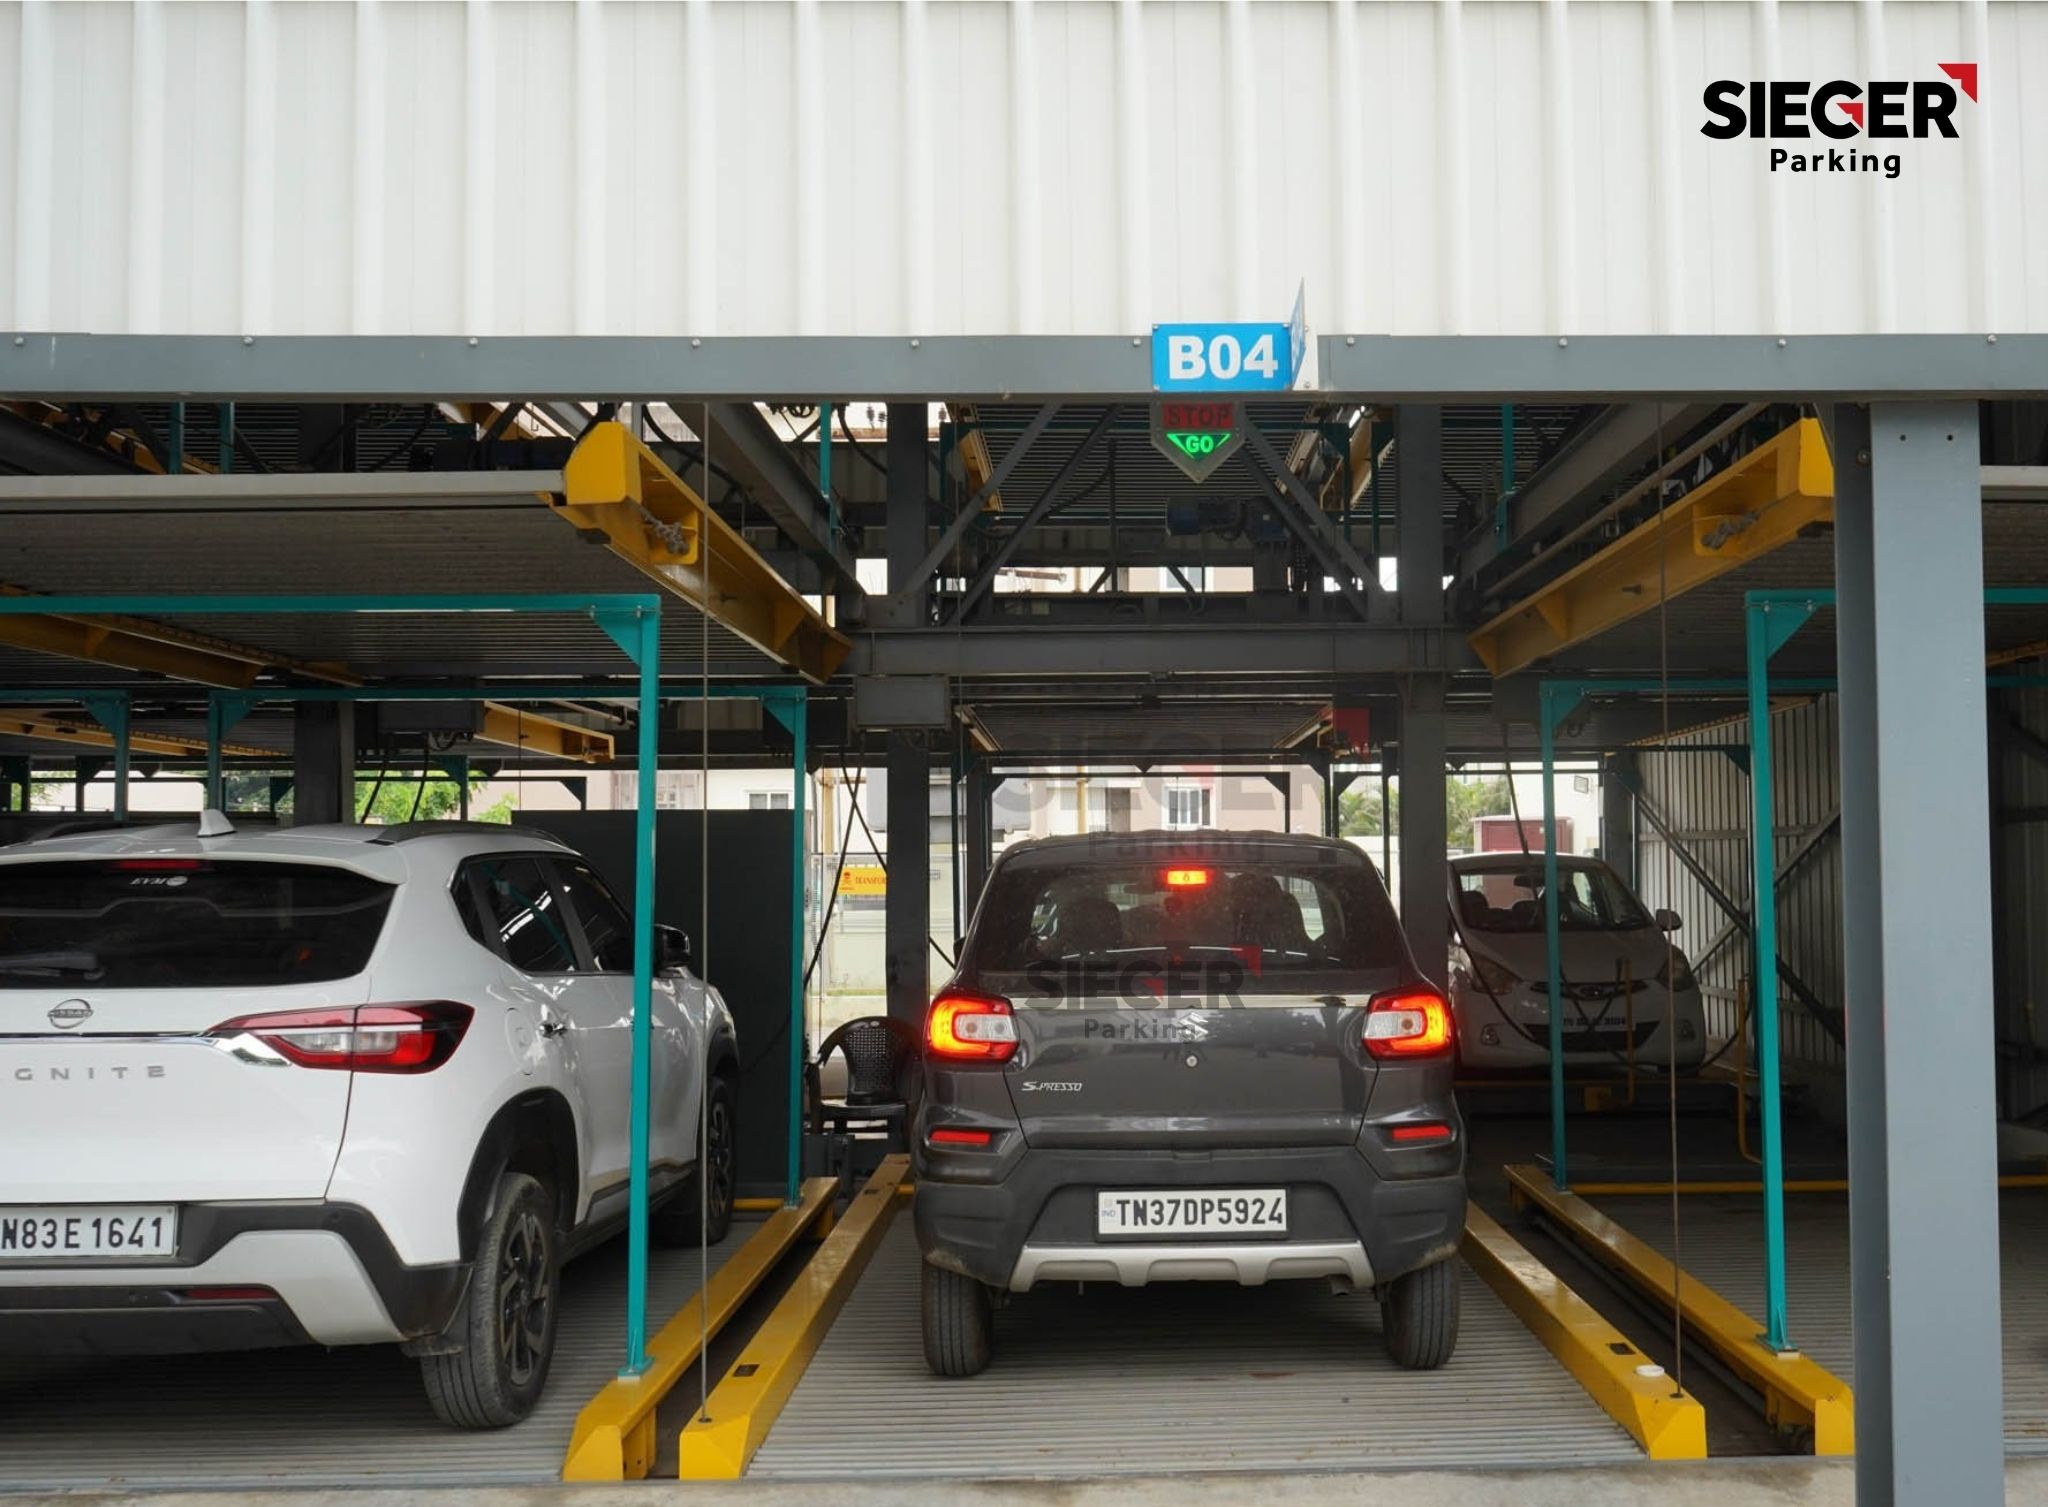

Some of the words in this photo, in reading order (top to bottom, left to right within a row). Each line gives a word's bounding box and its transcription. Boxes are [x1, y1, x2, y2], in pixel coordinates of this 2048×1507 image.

[1168, 334, 1279, 380] B04
[1166, 405, 1233, 427] STOP
[1185, 436, 1214, 453] GO
[14, 1065, 166, 1081] GNITE
[1116, 1197, 1283, 1226] TN37DP5924
